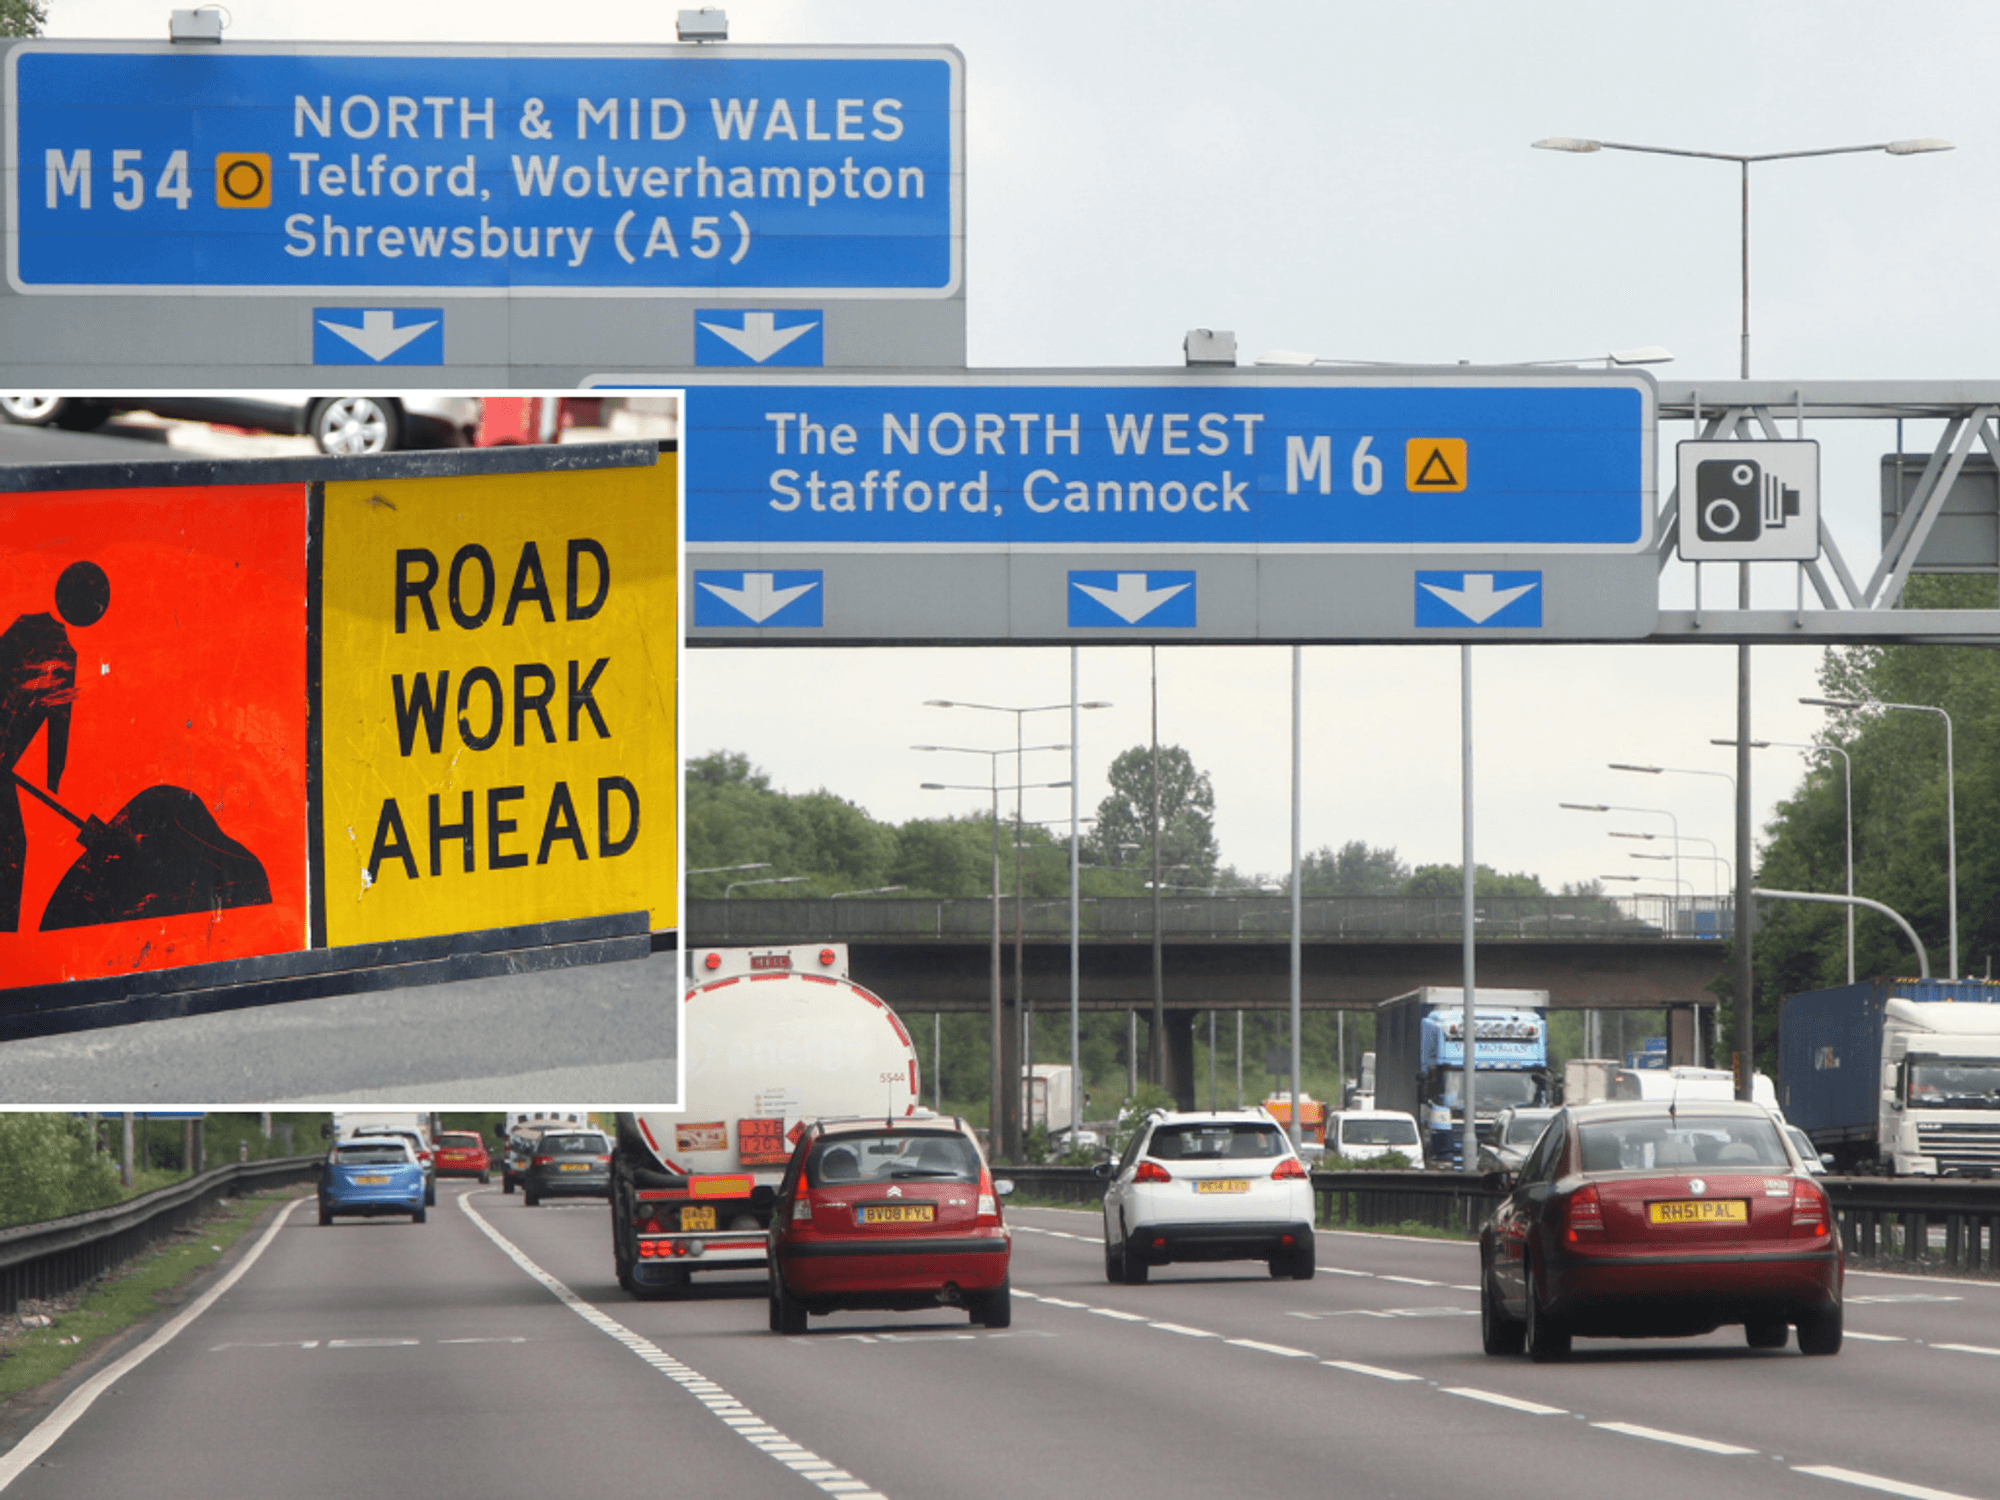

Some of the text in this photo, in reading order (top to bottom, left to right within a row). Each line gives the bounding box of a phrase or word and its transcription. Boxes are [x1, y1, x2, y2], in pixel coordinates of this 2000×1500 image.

[294, 95, 904, 141] NORTH & MID WALES
[289, 152, 925, 207] Telford, Wolverhampton
[284, 213, 594, 267] Shrewsbury
[765, 412, 1265, 456] The NORTH WEST
[769, 468, 1250, 517] Stafford, Cannock
[394, 537, 611, 634] ROAD
[391, 657, 612, 757] WORK
[366, 776, 641, 885] AHEAD
[1703, 1202, 1736, 1218] PAL
